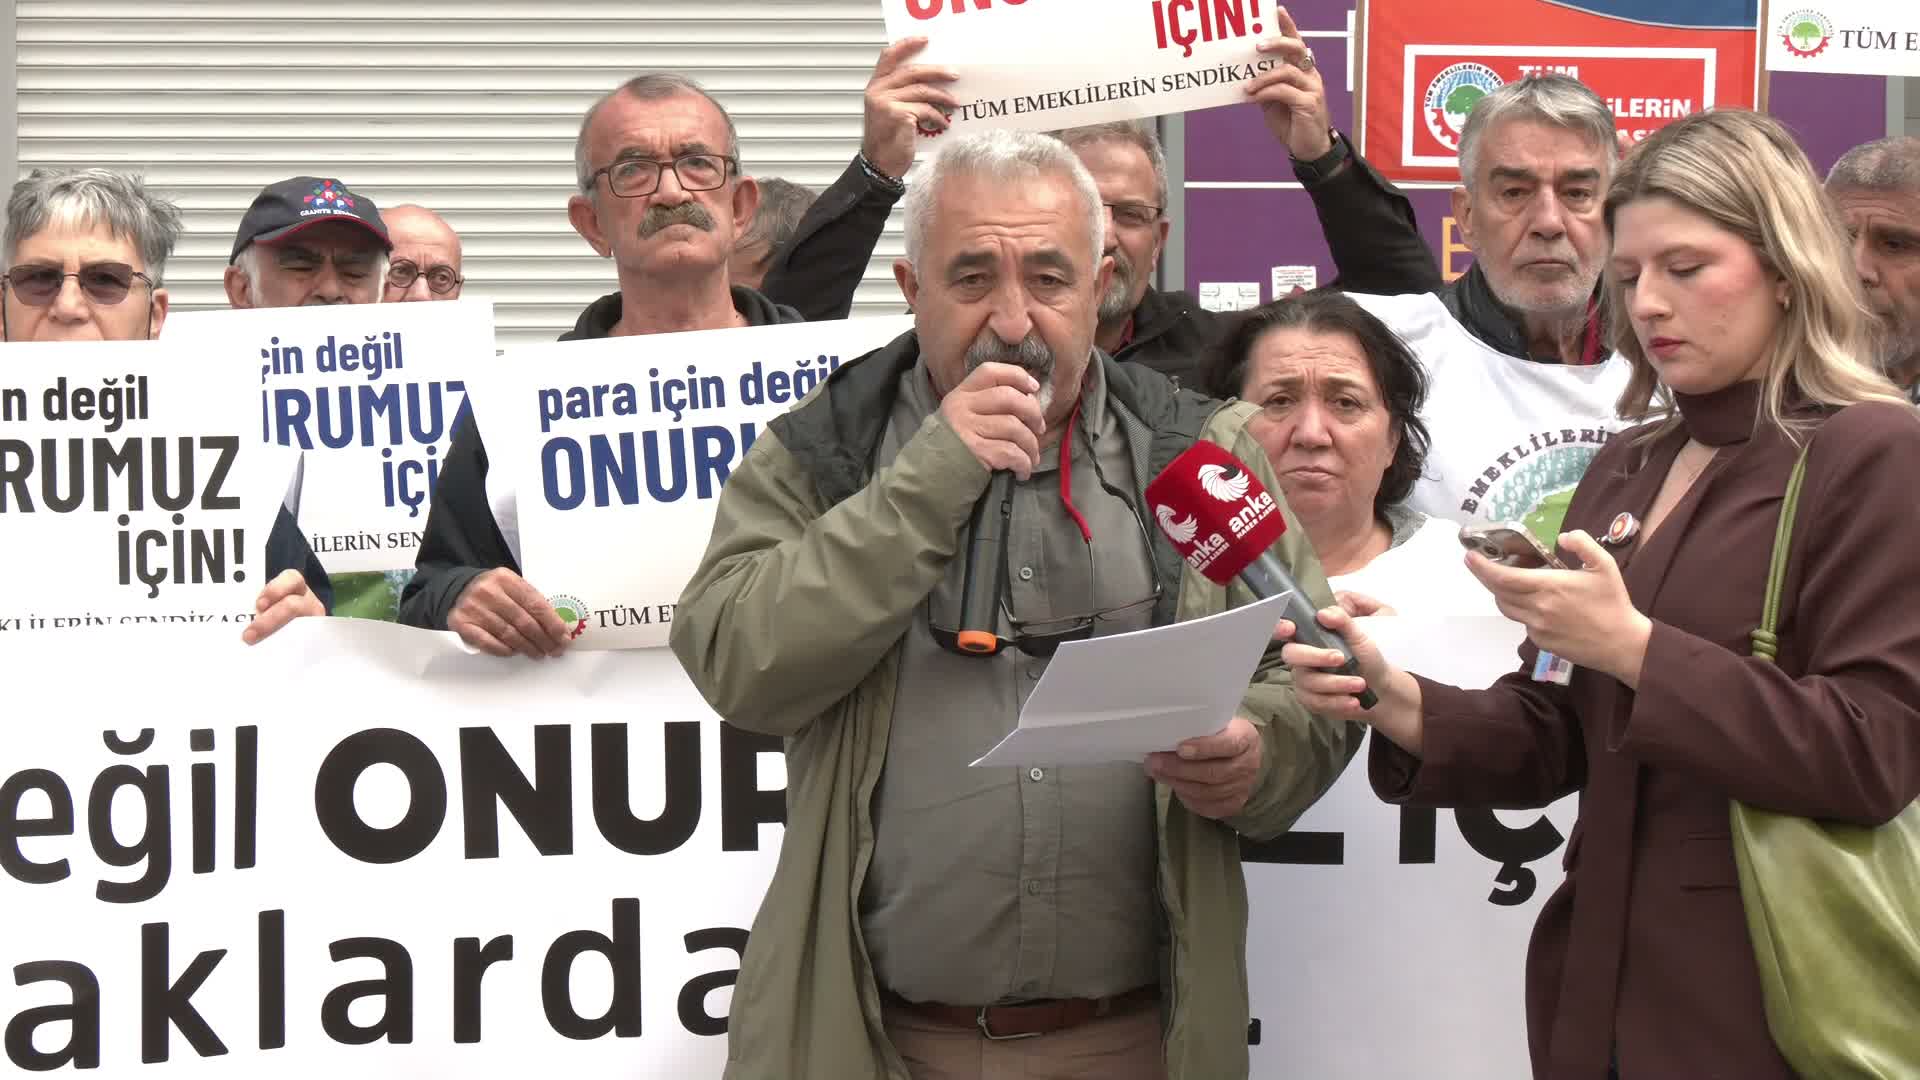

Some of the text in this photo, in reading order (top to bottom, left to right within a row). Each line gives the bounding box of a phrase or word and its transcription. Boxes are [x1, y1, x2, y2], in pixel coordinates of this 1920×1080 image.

[1840, 26, 1897, 50] TÜM
[960, 99, 1008, 121] TÜM
[1013, 77, 1156, 115] EMEKLİLERİN
[315, 331, 403, 381] değil
[43, 374, 148, 432] değil
[538, 381, 637, 433] para
[648, 364, 726, 422] için
[0, 436, 241, 513] RUMUZ
[540, 422, 756, 511] ONUR
[1228, 491, 1273, 533] anka
[117, 512, 246, 598] İÇİN!
[1186, 533, 1225, 568] anka
[594, 604, 652, 628] TÜM
[0, 724, 258, 904] eğil
[4, 896, 750, 1072] aklarda
